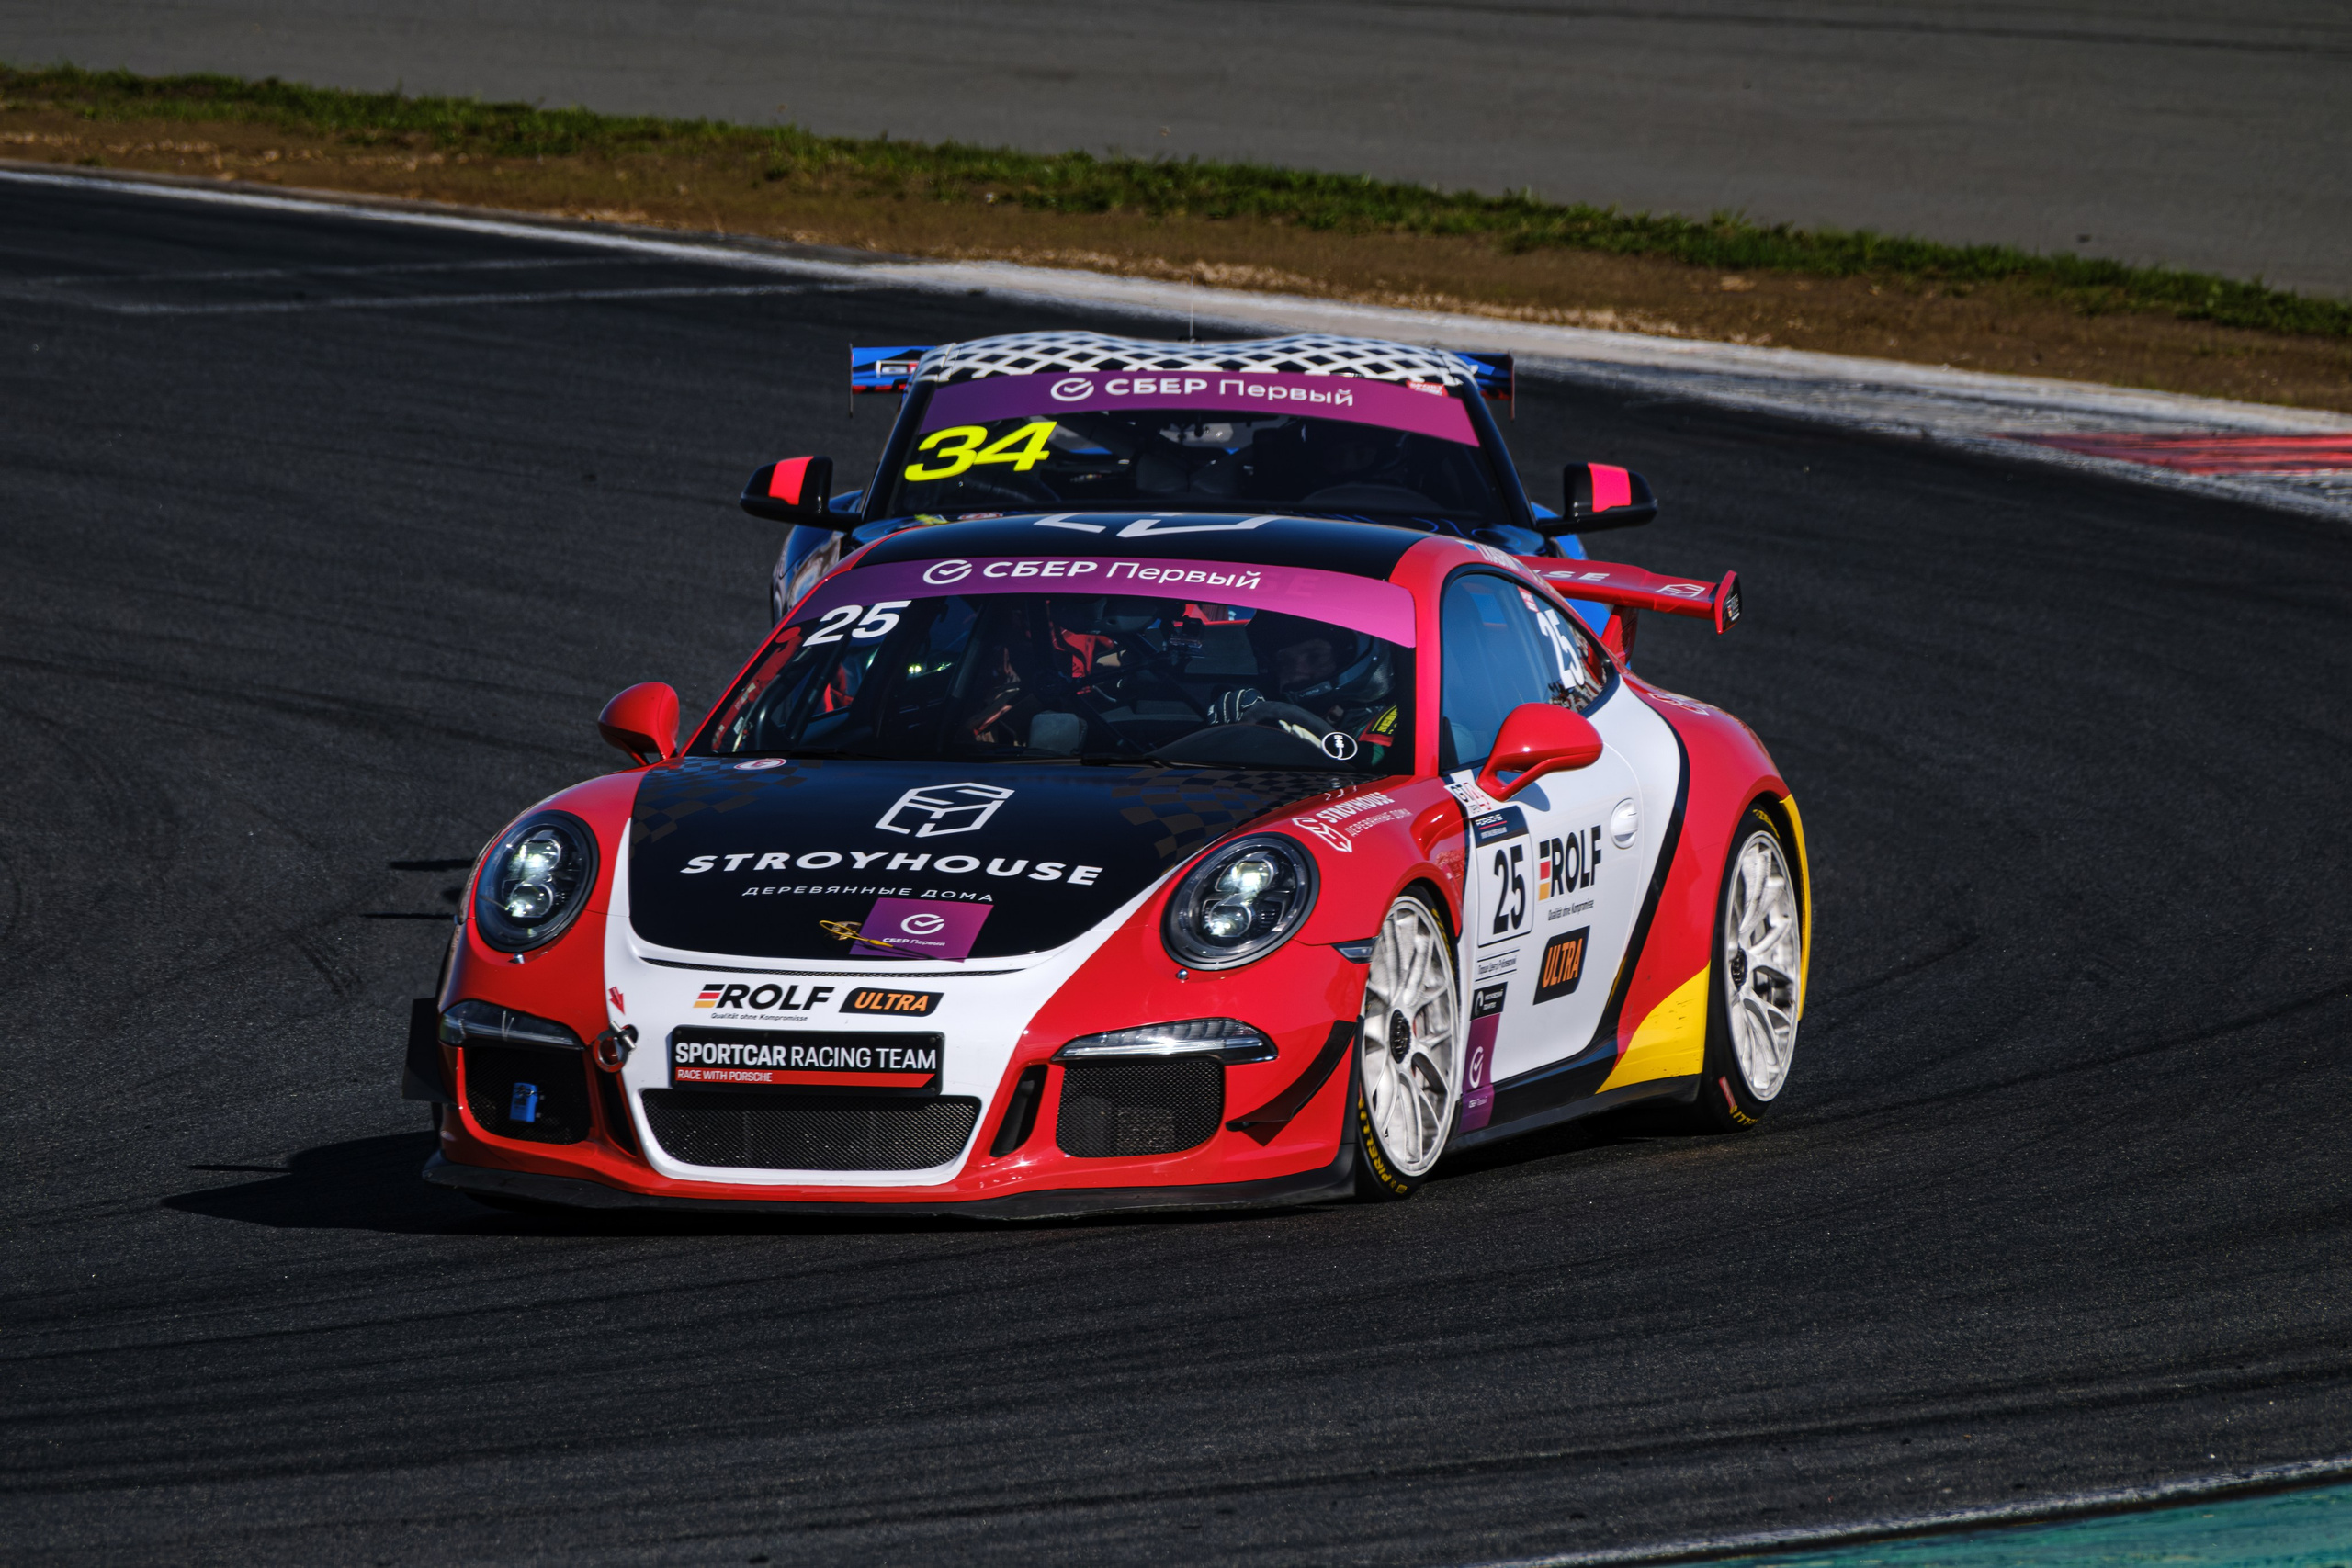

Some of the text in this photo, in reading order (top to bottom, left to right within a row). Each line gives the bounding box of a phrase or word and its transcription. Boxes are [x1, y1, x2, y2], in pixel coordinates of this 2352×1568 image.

[1105, 378, 1353, 406] СБЕР Первый
[904, 421, 1058, 482] 34
[982, 560, 1262, 590] СБЕР Первый
[803, 600, 912, 647] 25
[1536, 609, 1585, 689] 25
[1316, 792, 1395, 823] STROYHOUSE
[680, 852, 1103, 886] STROYHOUSE
[1550, 824, 1602, 898] ROLF
[741, 886, 994, 902] ДЕРЕВЯННЫЕ ДОМА
[1493, 844, 1526, 935] 25
[1542, 938, 1583, 989] ULTRA
[716, 983, 835, 1011] ROLF
[854, 991, 931, 1012] ULTRA
[759, 1013, 808, 1021] Kompromisse
[675, 1042, 937, 1070] SPORTCAR RACING TEAM
[677, 1068, 773, 1082] RACE WITH PORSCHE
